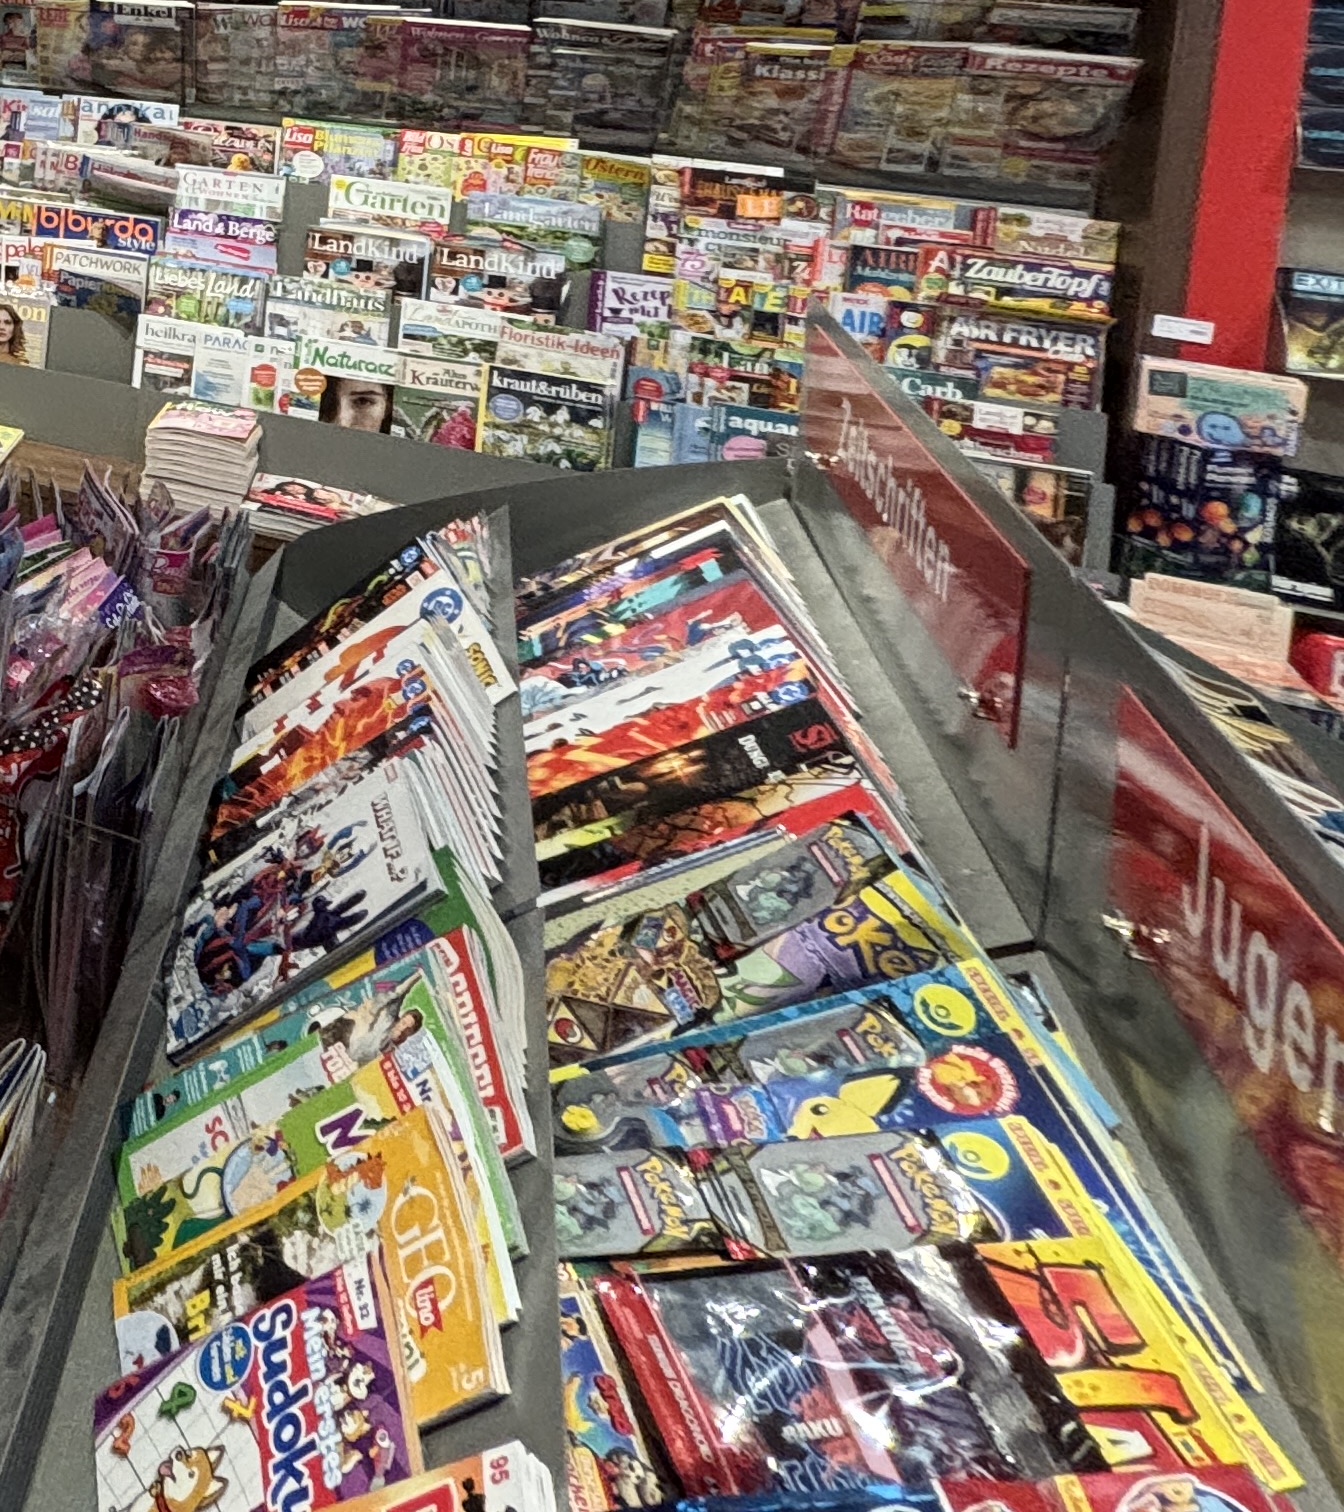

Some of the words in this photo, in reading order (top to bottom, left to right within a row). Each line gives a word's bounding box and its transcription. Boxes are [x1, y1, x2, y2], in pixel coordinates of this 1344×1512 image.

[173, 214, 213, 233] Land
[227, 222, 275, 245] Berge
[54, 251, 143, 276] PATCHWORK
[312, 232, 420, 265] LandKind
[439, 246, 558, 281] LandKind
[492, 370, 604, 405] kraut&rüben
[390, 1177, 459, 1321] GEO
[301, 1306, 327, 1381] Mein
